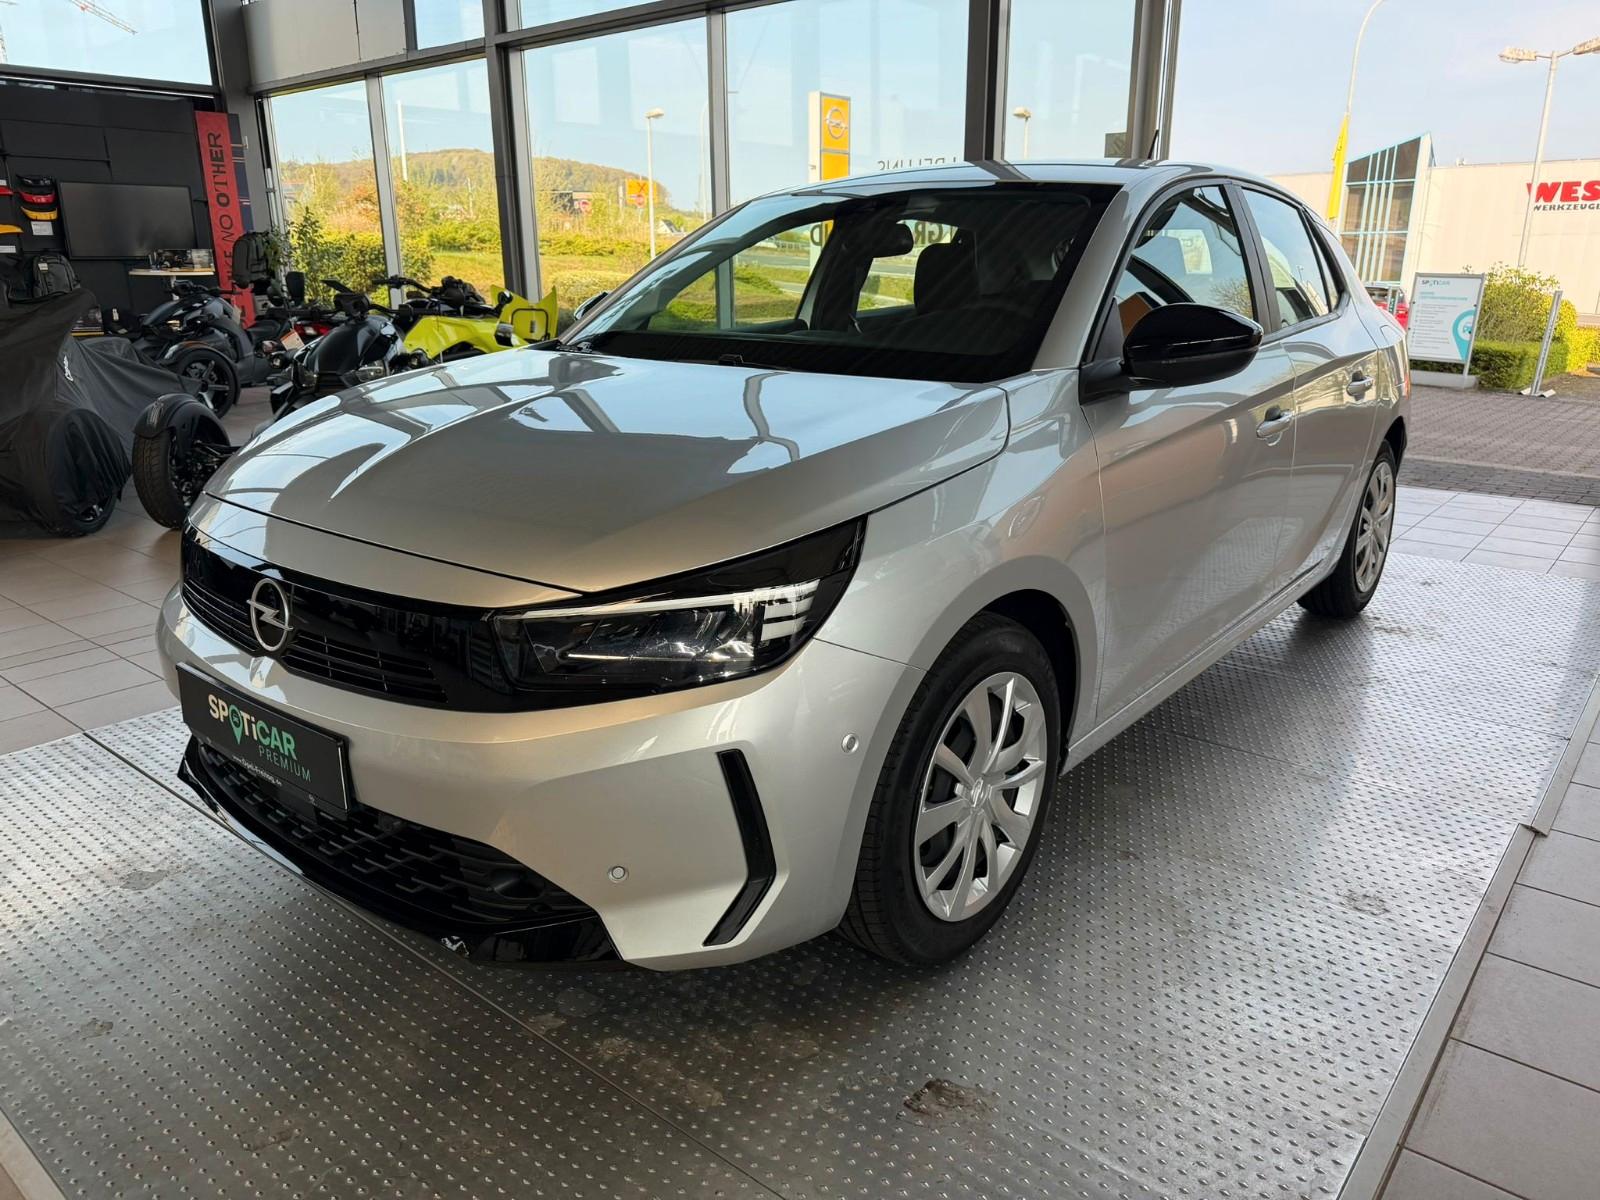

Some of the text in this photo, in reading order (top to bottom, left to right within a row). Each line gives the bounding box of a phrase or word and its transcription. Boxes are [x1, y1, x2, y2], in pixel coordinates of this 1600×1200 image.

[207, 131, 231, 208] OTHER
[219, 213, 235, 244] NO
[258, 745, 312, 782] PREMIUM
